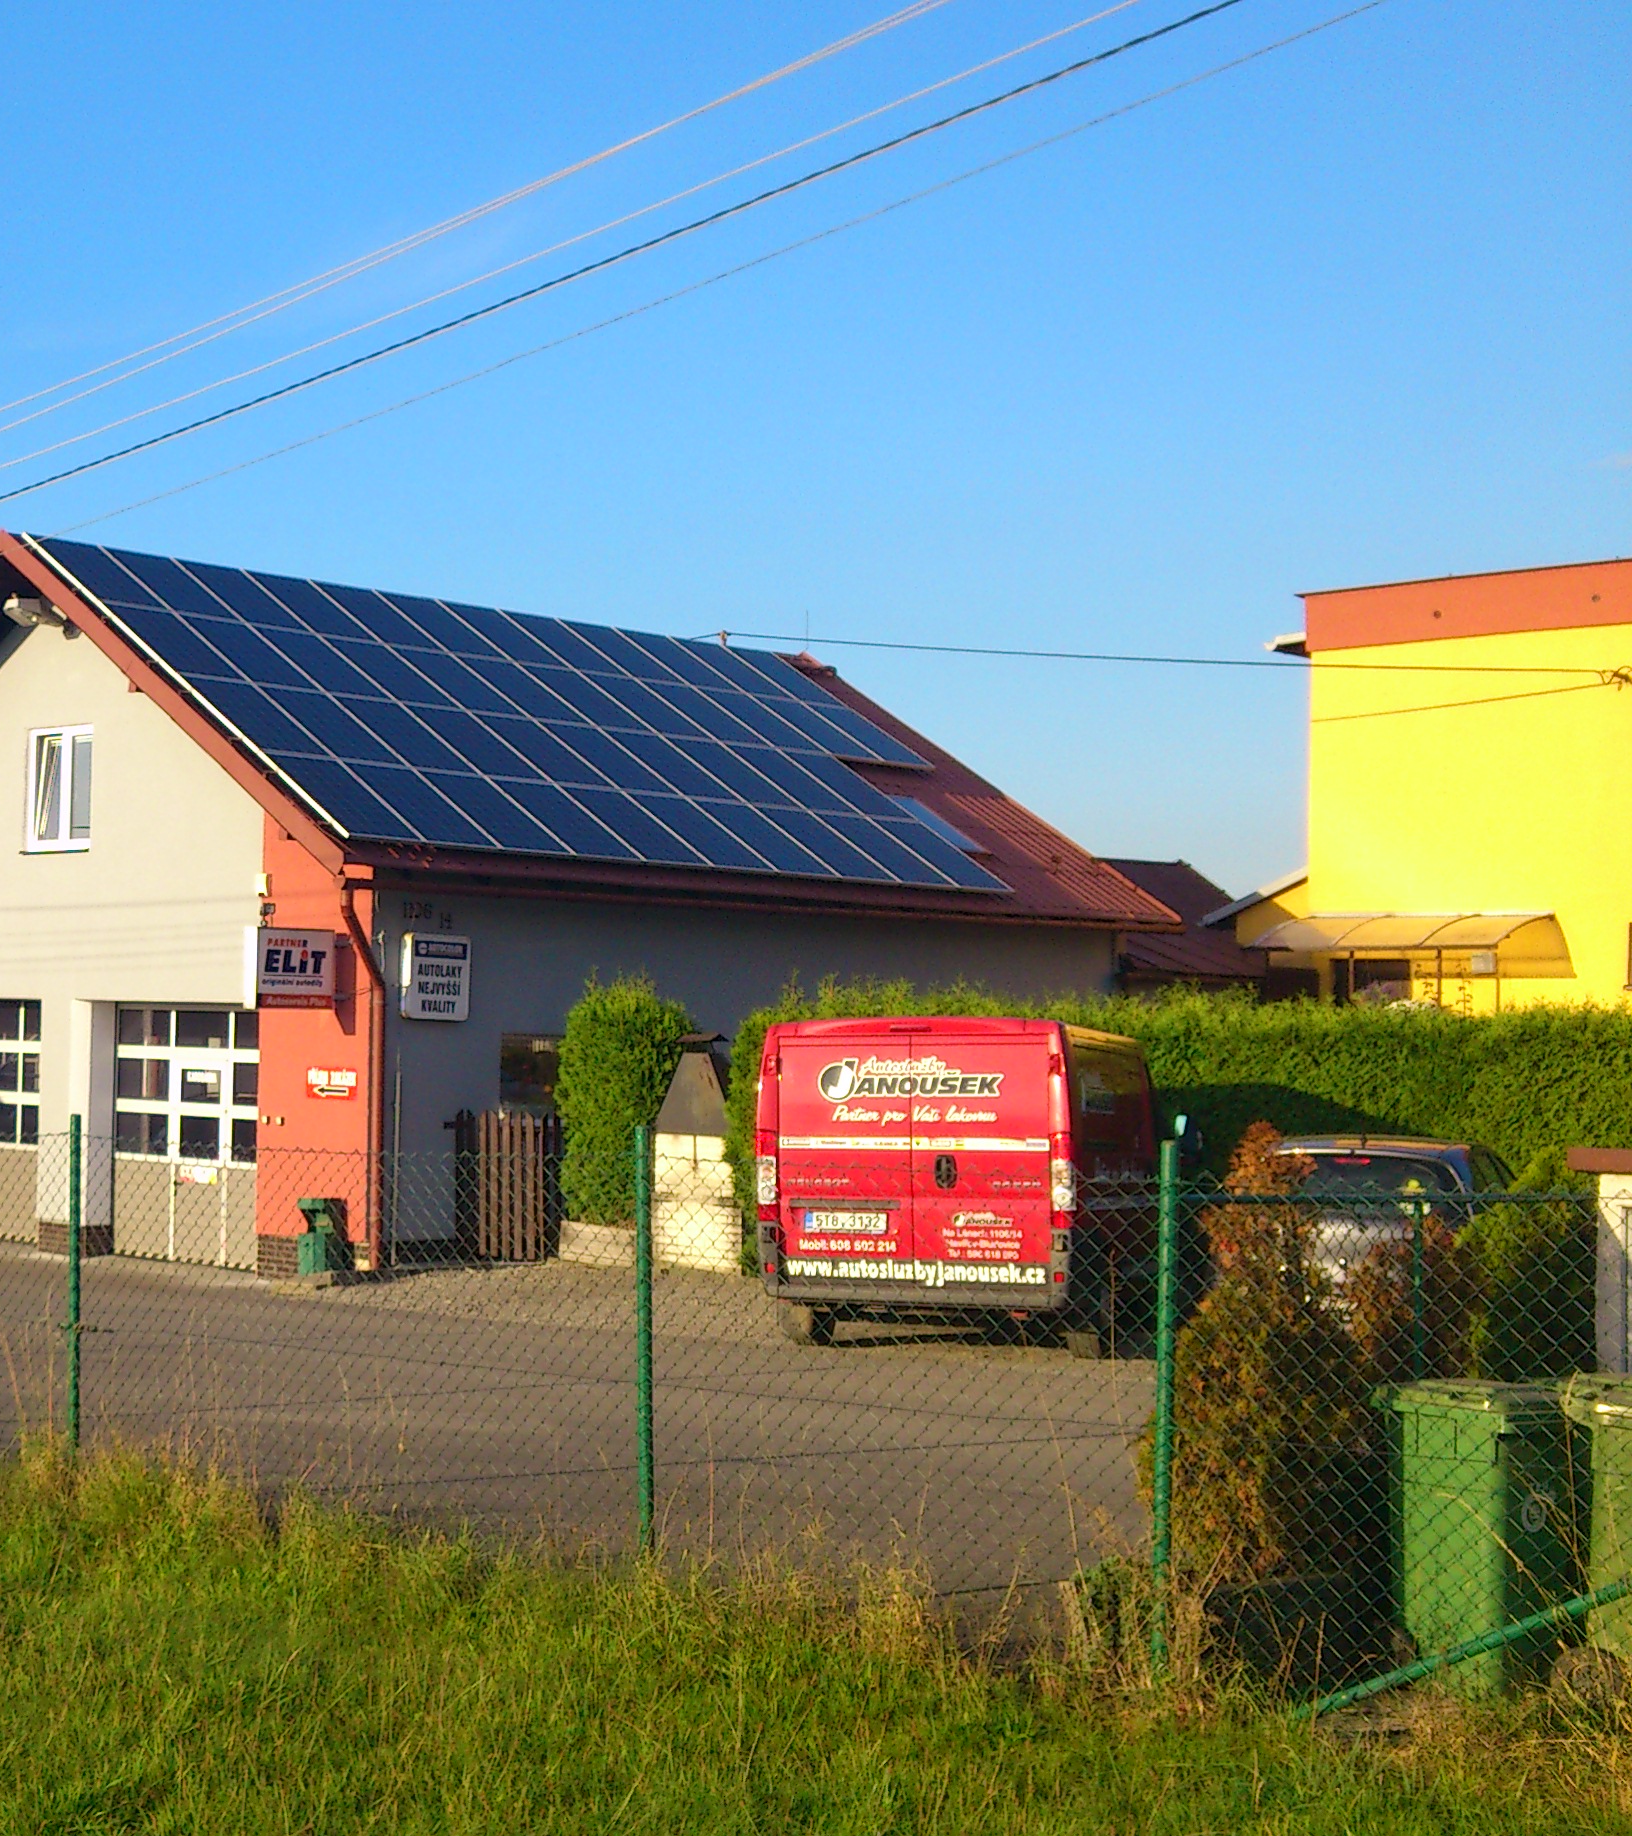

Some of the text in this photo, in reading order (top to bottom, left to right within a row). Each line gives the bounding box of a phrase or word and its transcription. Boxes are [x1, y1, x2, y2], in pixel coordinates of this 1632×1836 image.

[267, 938, 308, 948] PARTNER
[417, 963, 463, 979] AUTOLAKY
[417, 980, 461, 996] NEJVYŠŠÍ
[421, 999, 457, 1014] KVALITY
[818, 1058, 1004, 1104] JANOUŠEK
[831, 1105, 880, 1122] Partner
[881, 1110, 908, 1126] pro
[944, 1105, 998, 1123] lakovnu
[815, 1213, 882, 1229] 5T8 3132
[877, 1240, 897, 1253] 214
[786, 1259, 1047, 1288] www.autosluzbyjanousek.cz
